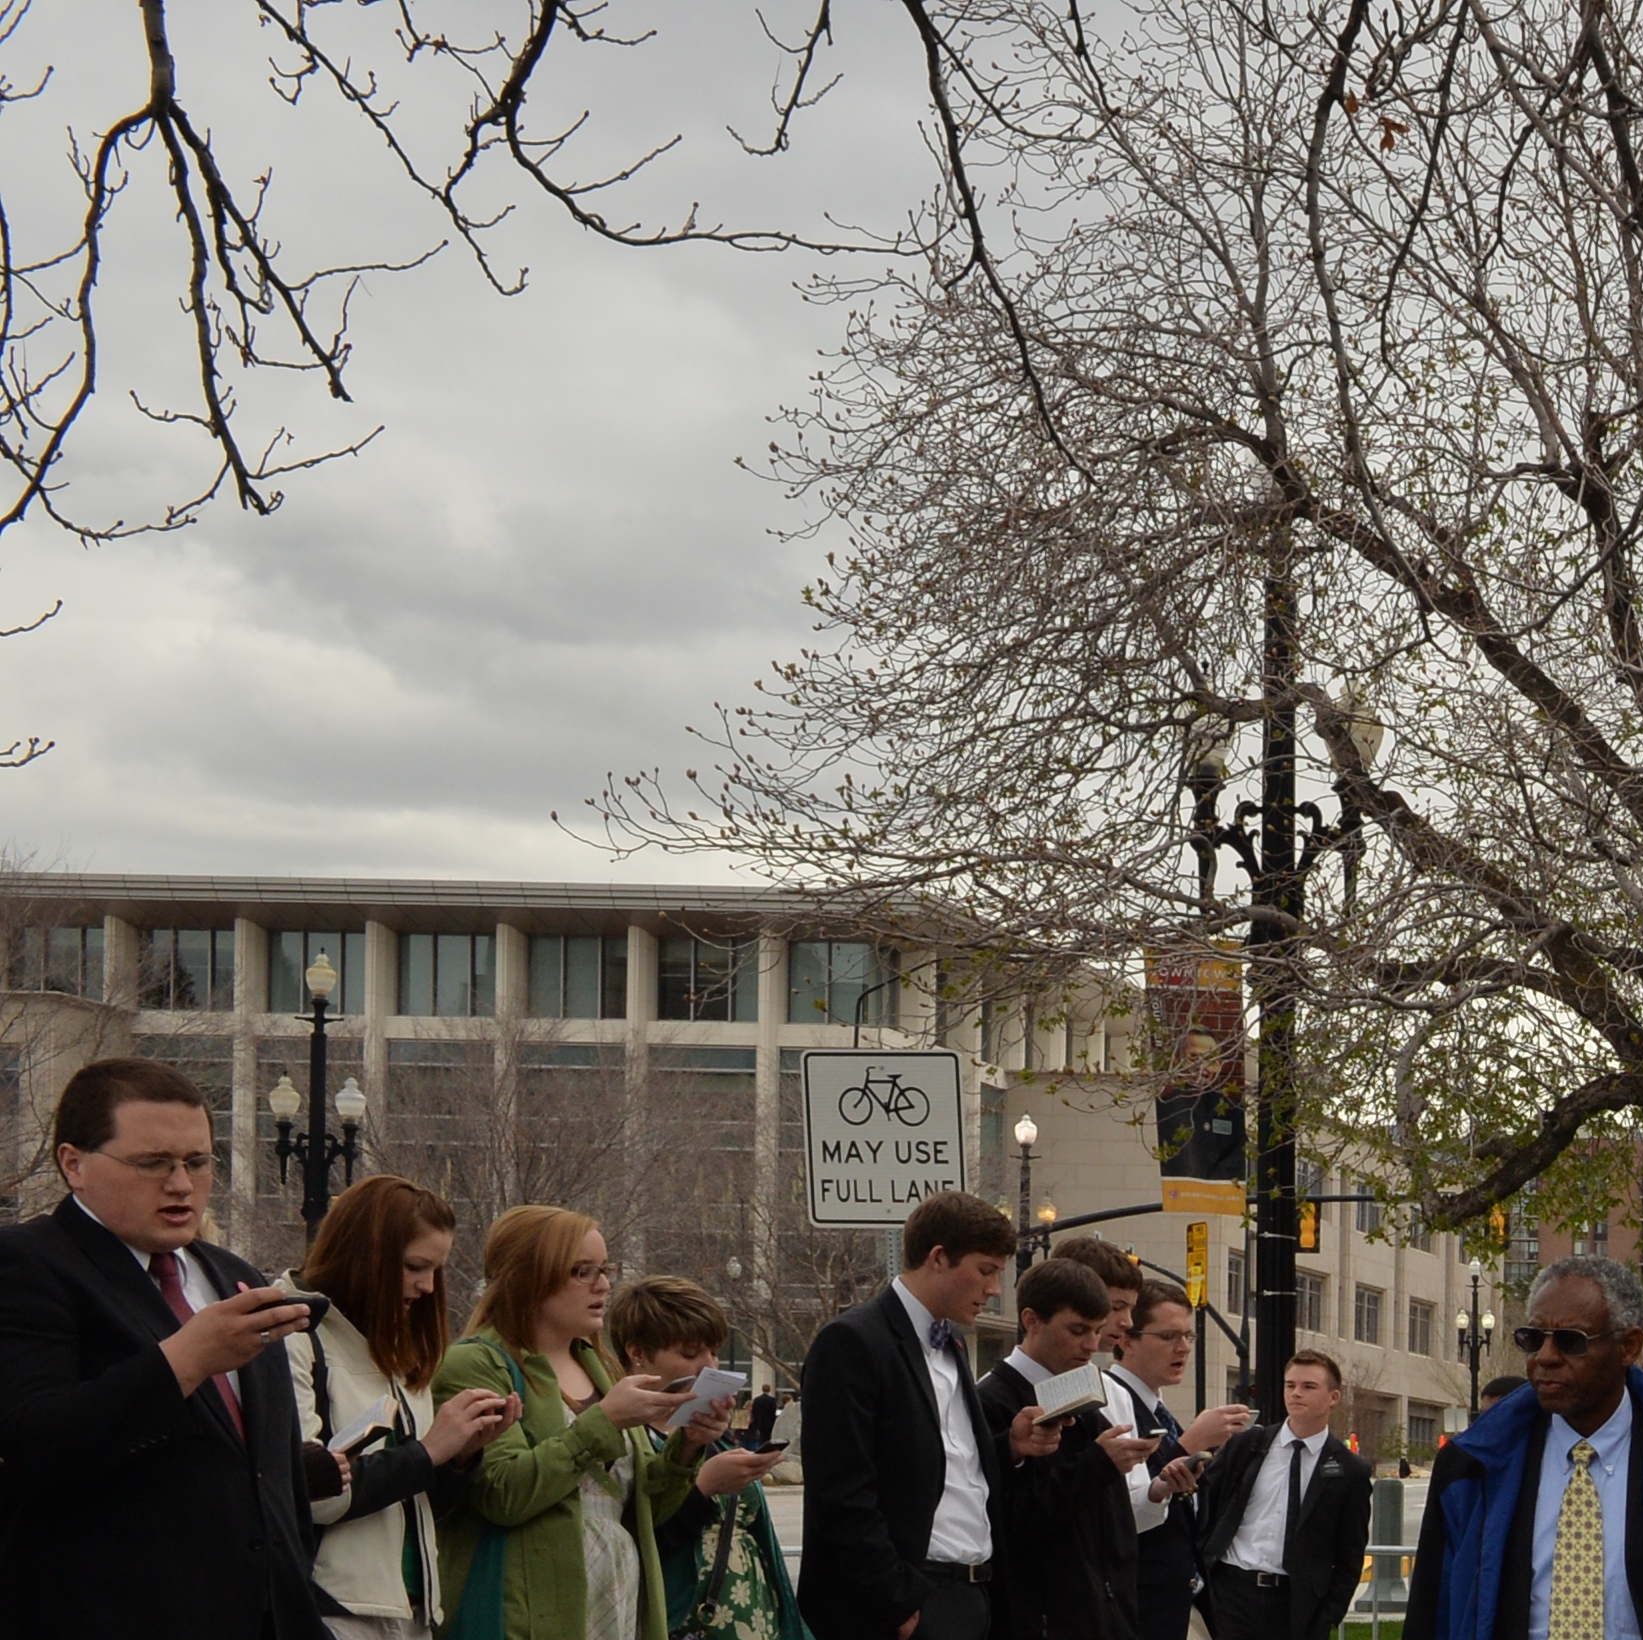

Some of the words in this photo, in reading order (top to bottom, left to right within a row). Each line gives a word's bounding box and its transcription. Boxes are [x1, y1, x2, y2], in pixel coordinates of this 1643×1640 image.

[822, 1140, 883, 1163] MAY
[895, 1141, 949, 1164] USE
[821, 1180, 883, 1202] FULL
